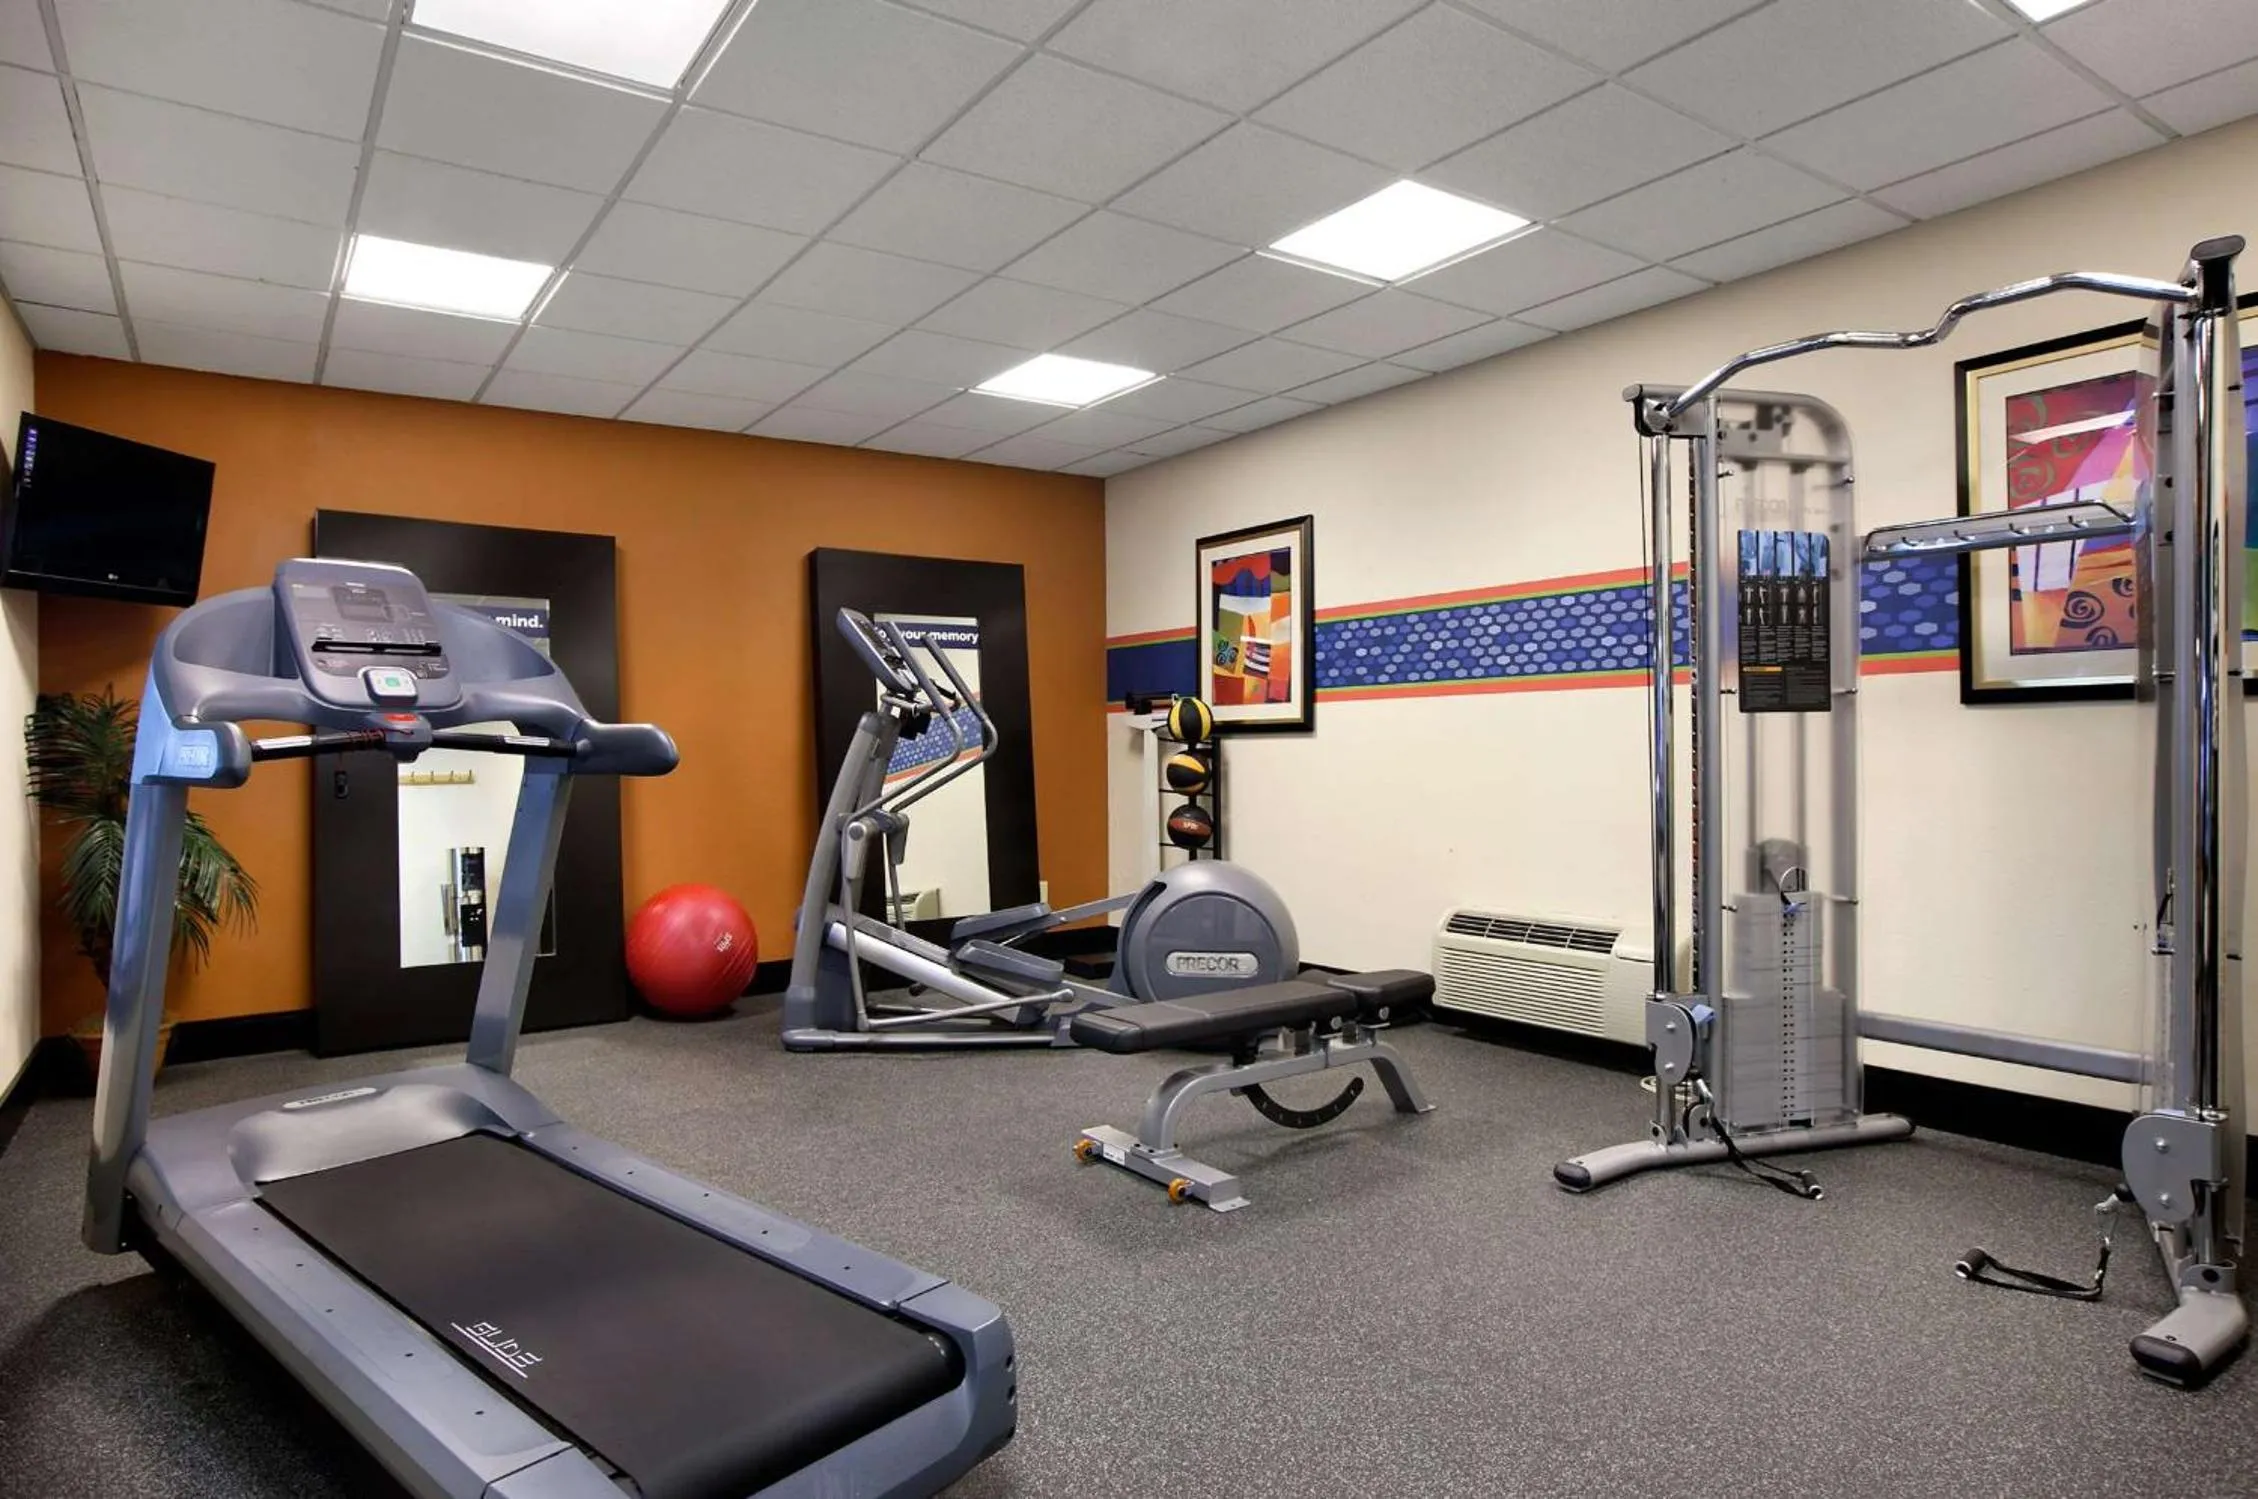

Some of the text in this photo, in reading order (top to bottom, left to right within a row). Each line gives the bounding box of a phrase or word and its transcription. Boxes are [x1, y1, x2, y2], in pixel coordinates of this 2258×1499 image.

[495, 613, 544, 628] mind.
[929, 631, 979, 645] memory
[1176, 956, 1239, 971] PRECOR
[465, 1322, 543, 1368] GLIDE
